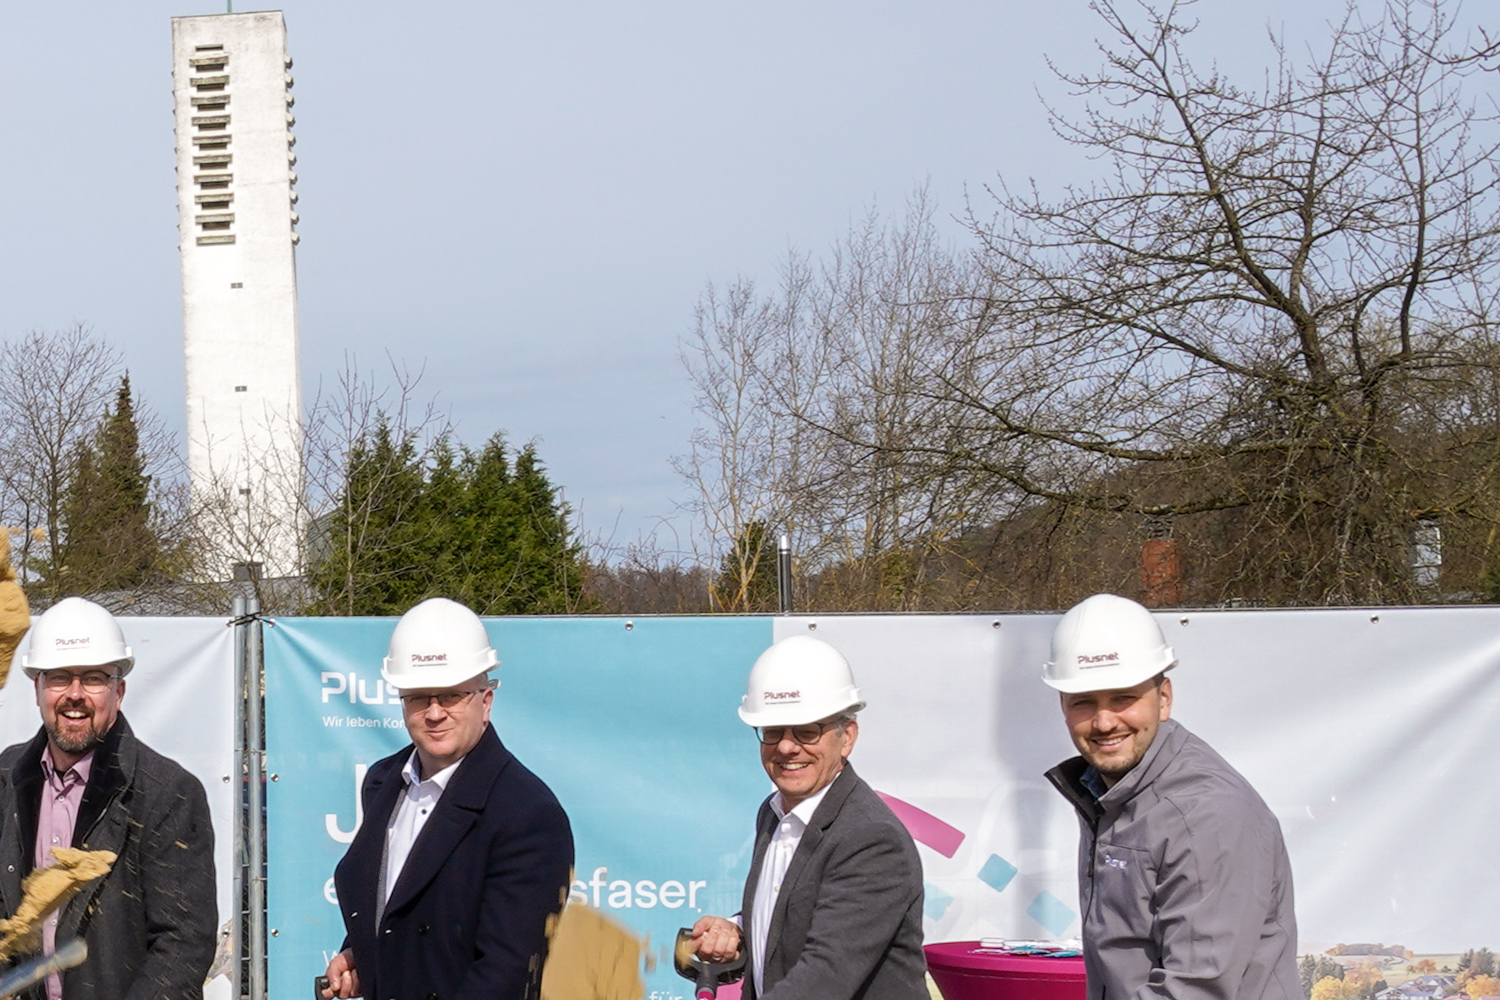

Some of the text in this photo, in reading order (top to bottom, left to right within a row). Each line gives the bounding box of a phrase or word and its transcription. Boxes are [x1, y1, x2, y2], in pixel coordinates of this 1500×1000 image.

[411, 652, 447, 662] Plusnet
[1077, 652, 1120, 664] Plusnet
[763, 690, 801, 700] Plusnet
[322, 715, 344, 728] Wir
[346, 716, 382, 729] leben
